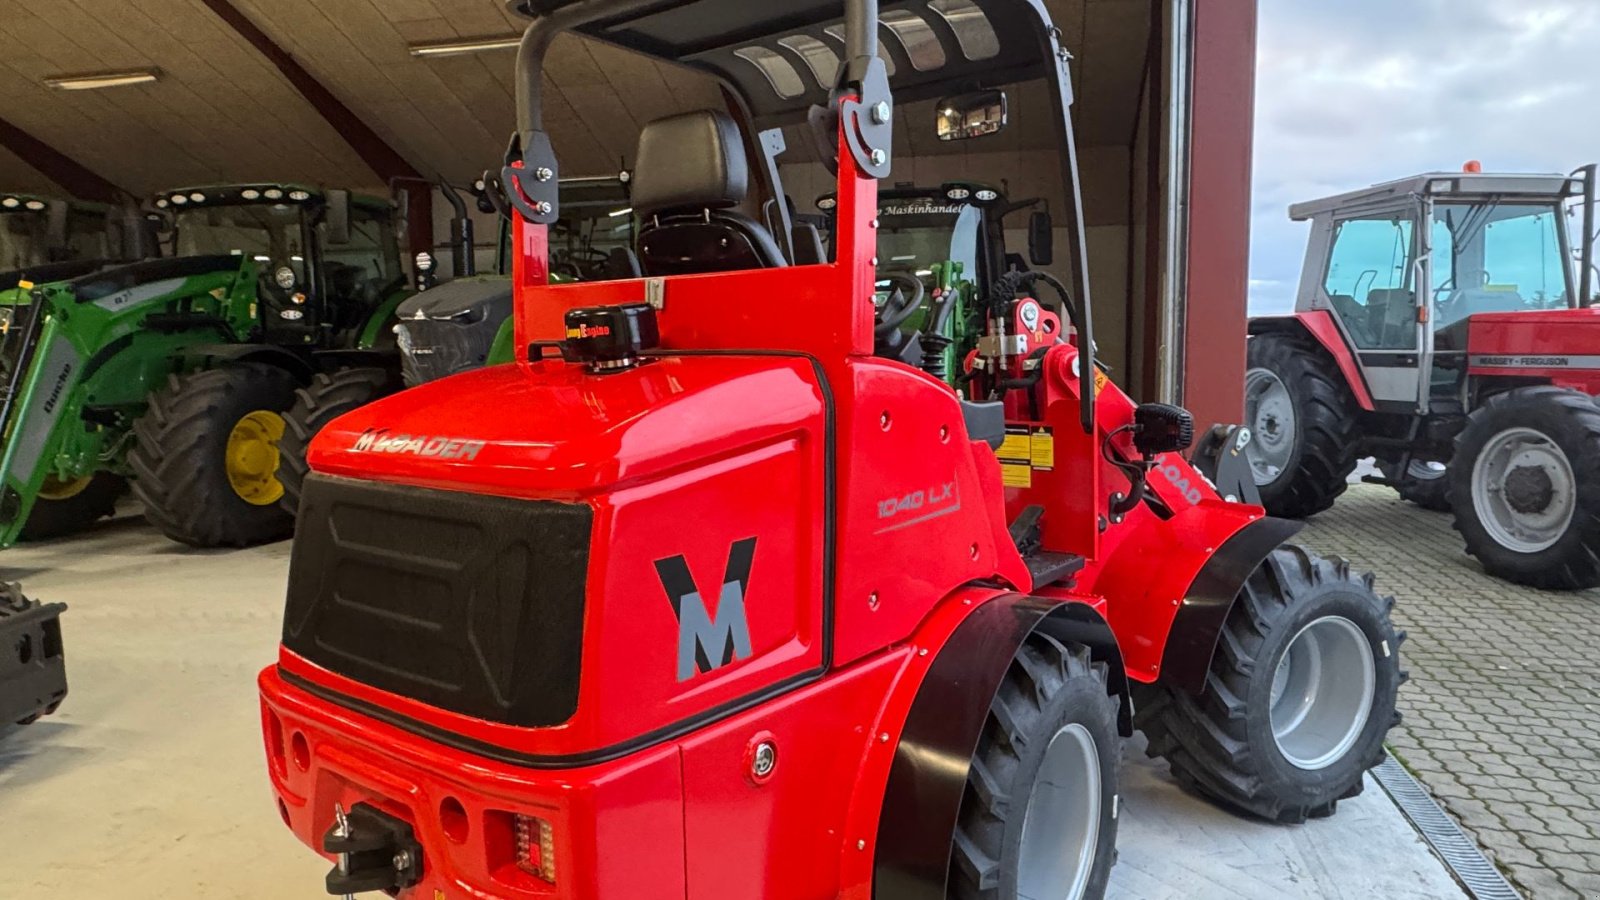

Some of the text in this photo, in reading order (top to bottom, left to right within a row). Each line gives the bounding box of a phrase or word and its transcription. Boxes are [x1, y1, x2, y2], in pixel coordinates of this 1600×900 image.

[884, 203, 964, 216] Maskinhandel
[1479, 357, 1514, 366] MASSEY
[1520, 357, 1569, 366] FERGUSON
[877, 482, 955, 520] 1040 LX
